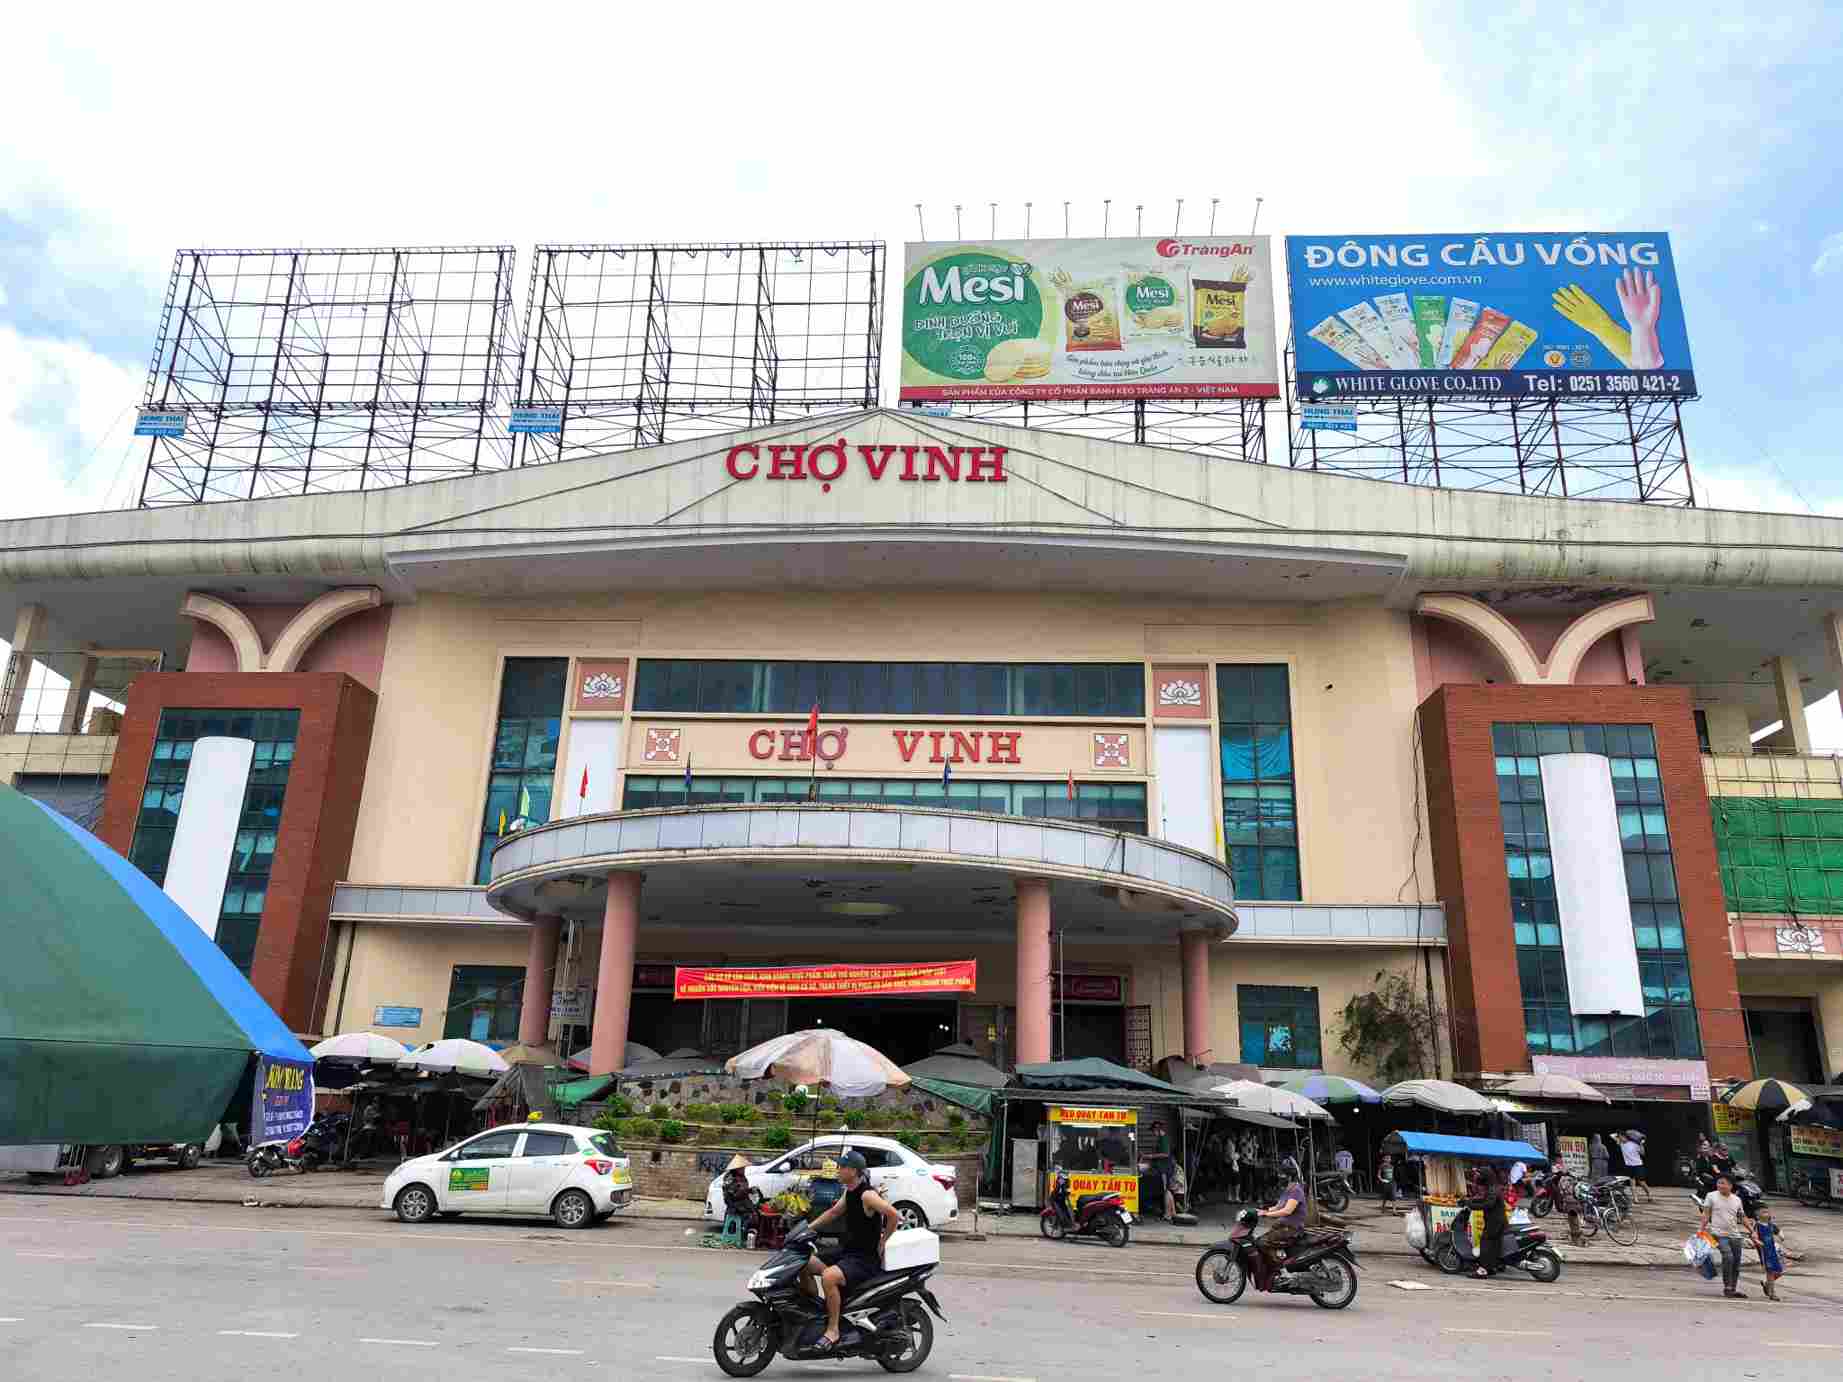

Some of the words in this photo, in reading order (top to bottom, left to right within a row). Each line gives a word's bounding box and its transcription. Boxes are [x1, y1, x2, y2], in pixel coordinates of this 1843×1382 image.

[1304, 240, 1429, 268] ĐÔNG
[1440, 236, 1525, 267] CẦU
[1309, 273, 1482, 288] www.whiteglove.com.vn
[1072, 300, 1099, 312] Mesi
[1335, 376, 1386, 392] WHITE
[1389, 376, 1441, 392] GLOVE
[1523, 375, 1563, 392] Tel:
[1569, 375, 1601, 392] 0251
[1606, 375, 1639, 392] 3560
[1642, 375, 1681, 391] 421-2
[726, 438, 849, 494] CHỢ
[857, 445, 1009, 483] VINH
[748, 726, 849, 771] CHỢ
[893, 730, 1023, 764] VINH
